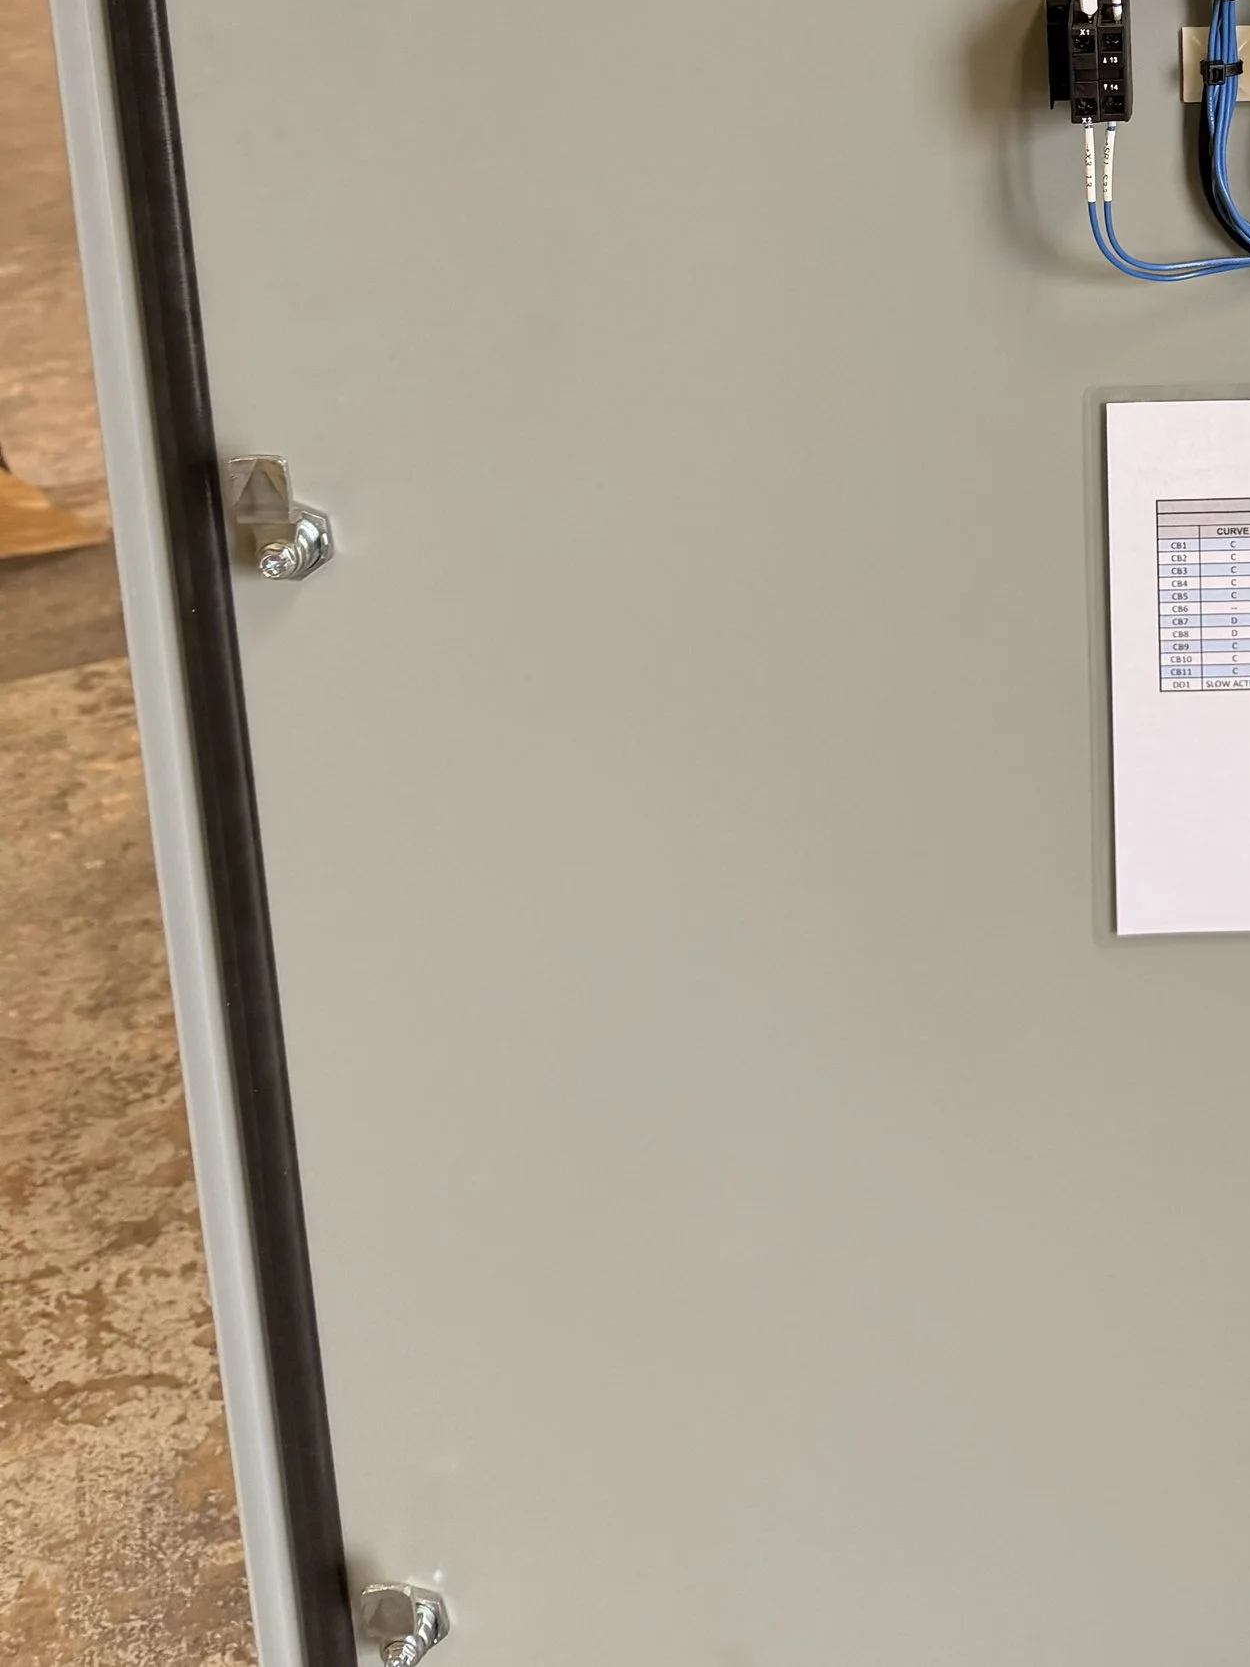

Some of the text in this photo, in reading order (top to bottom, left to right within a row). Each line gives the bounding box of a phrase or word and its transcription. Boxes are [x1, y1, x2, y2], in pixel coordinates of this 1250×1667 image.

[1216, 527, 1248, 535] CURVE
[1170, 554, 1187, 562] CB2
[1170, 566, 1187, 575] CB3
[1171, 592, 1188, 600] CB5
[1170, 655, 1192, 663] CB10
[1170, 668, 1191, 676] CB11
[1205, 679, 1230, 687] SLOW
